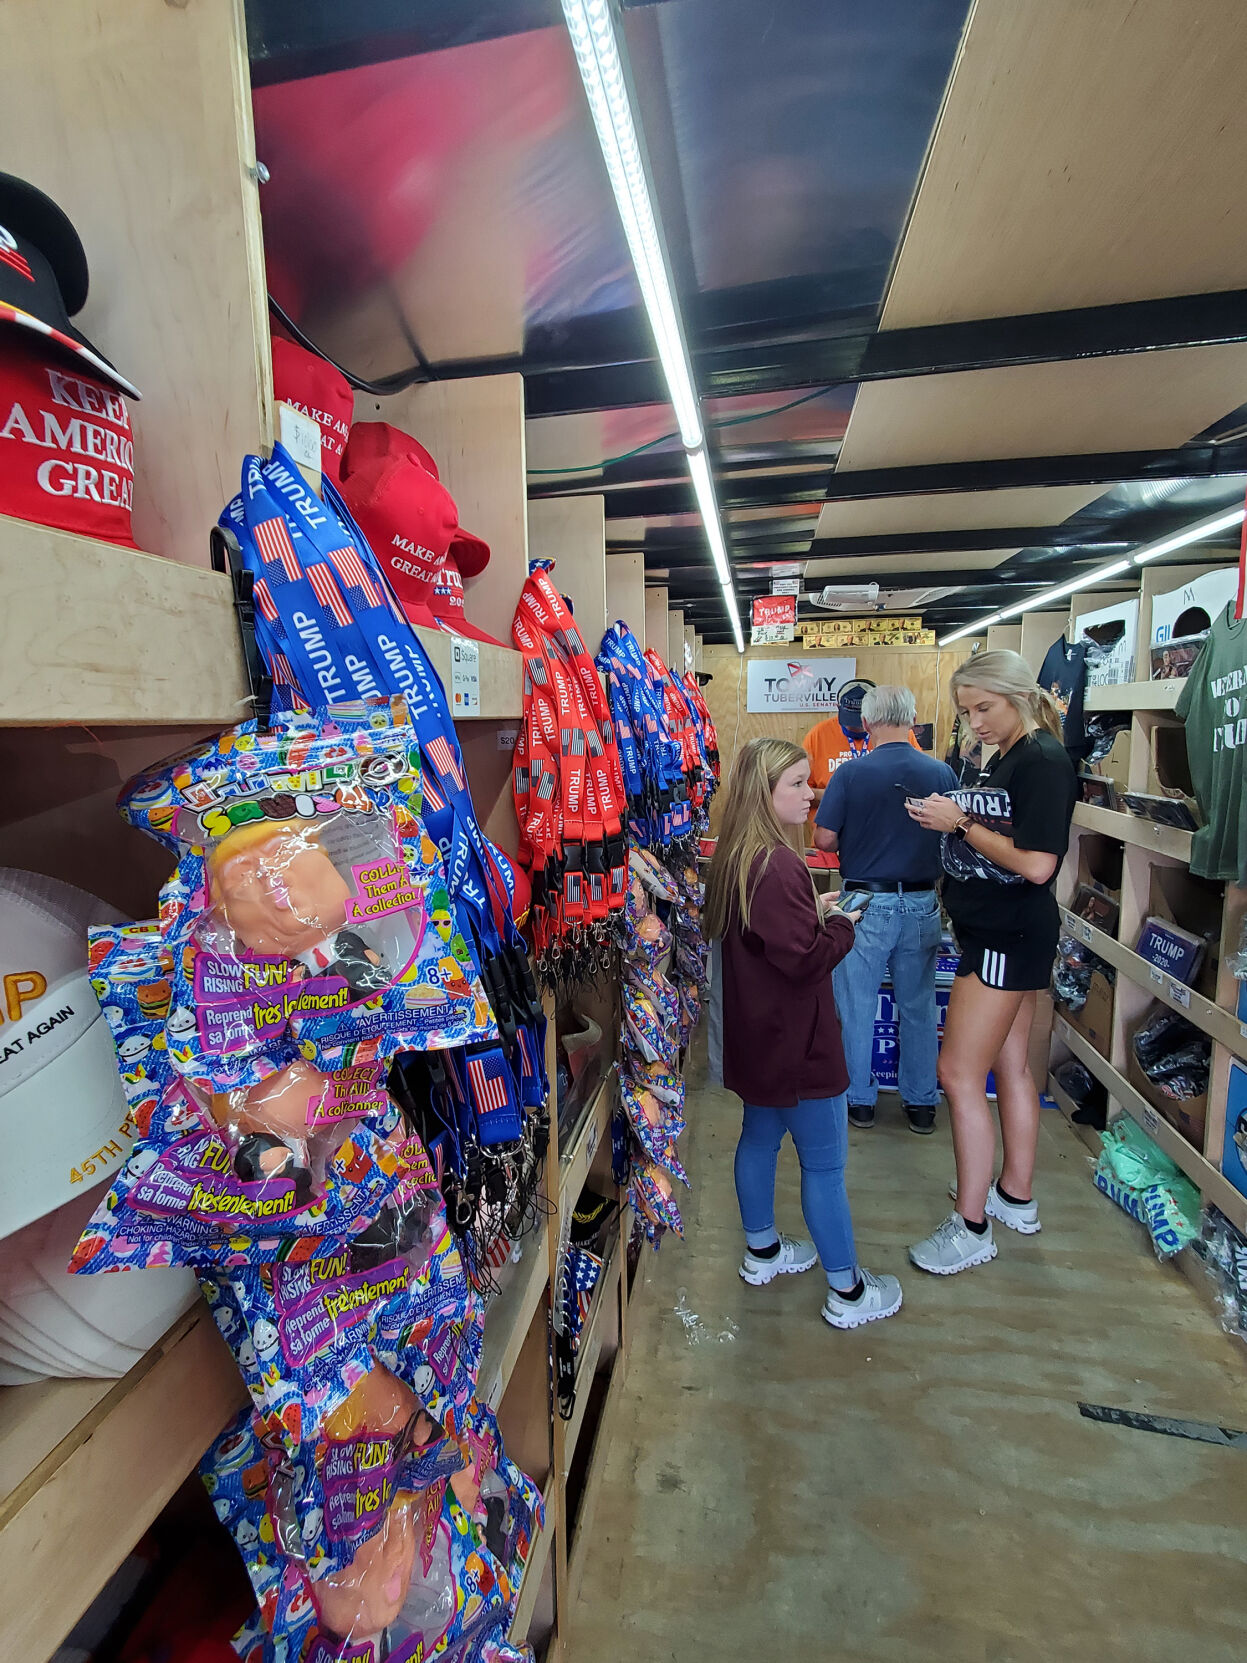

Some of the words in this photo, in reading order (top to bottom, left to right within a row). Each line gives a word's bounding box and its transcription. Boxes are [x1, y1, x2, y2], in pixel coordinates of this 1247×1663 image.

[0, 402, 135, 475] AMERIC
[261, 461, 327, 530] TRUMP
[391, 533, 435, 563] MAKE
[522, 592, 550, 626] TRUMP
[538, 578, 565, 619] TRUMP
[513, 616, 534, 650] TRUMP
[605, 637, 626, 658] TRUMP
[293, 611, 346, 705] TRUMP
[377, 634, 428, 721] TRUMP
[555, 671, 571, 716] TRUMP
[580, 667, 599, 706] TRUMP
[764, 692, 837, 703] TUBERVILLE
[538, 698, 556, 742] TRUMP
[625, 745, 637, 775] TRUMP
[568, 769, 581, 814] TRUMP
[586, 773, 597, 815] TRUMP
[597, 769, 614, 812] TRUMP
[365, 884, 398, 899] Them
[1150, 932, 1185, 961] TRUMP
[204, 976, 244, 993] RISING
[207, 960, 243, 978] SLOW
[243, 960, 288, 990] FUN!
[427, 967, 453, 985] 8+
[27, 1005, 75, 1044] AGAIN
[206, 1007, 253, 1028] Reprend
[253, 1001, 283, 1031] très
[359, 1002, 451, 1028] AVERTISSEMENT
[208, 1030, 224, 1046] sa
[69, 1139, 124, 1186] 45TH
[138, 1185, 153, 1202] sa
[153, 1190, 187, 1211] forme
[120, 1224, 163, 1235] CHOKING
[128, 1235, 141, 1243] Not
[143, 1234, 153, 1242] for
[310, 1252, 347, 1284] FUN!
[285, 1302, 326, 1335] Reprend
[290, 1337, 304, 1355] sa
[301, 1317, 331, 1345] forme
[326, 1461, 353, 1480] RISING
[354, 1440, 391, 1470] FUN!
[355, 1487, 380, 1520] très
